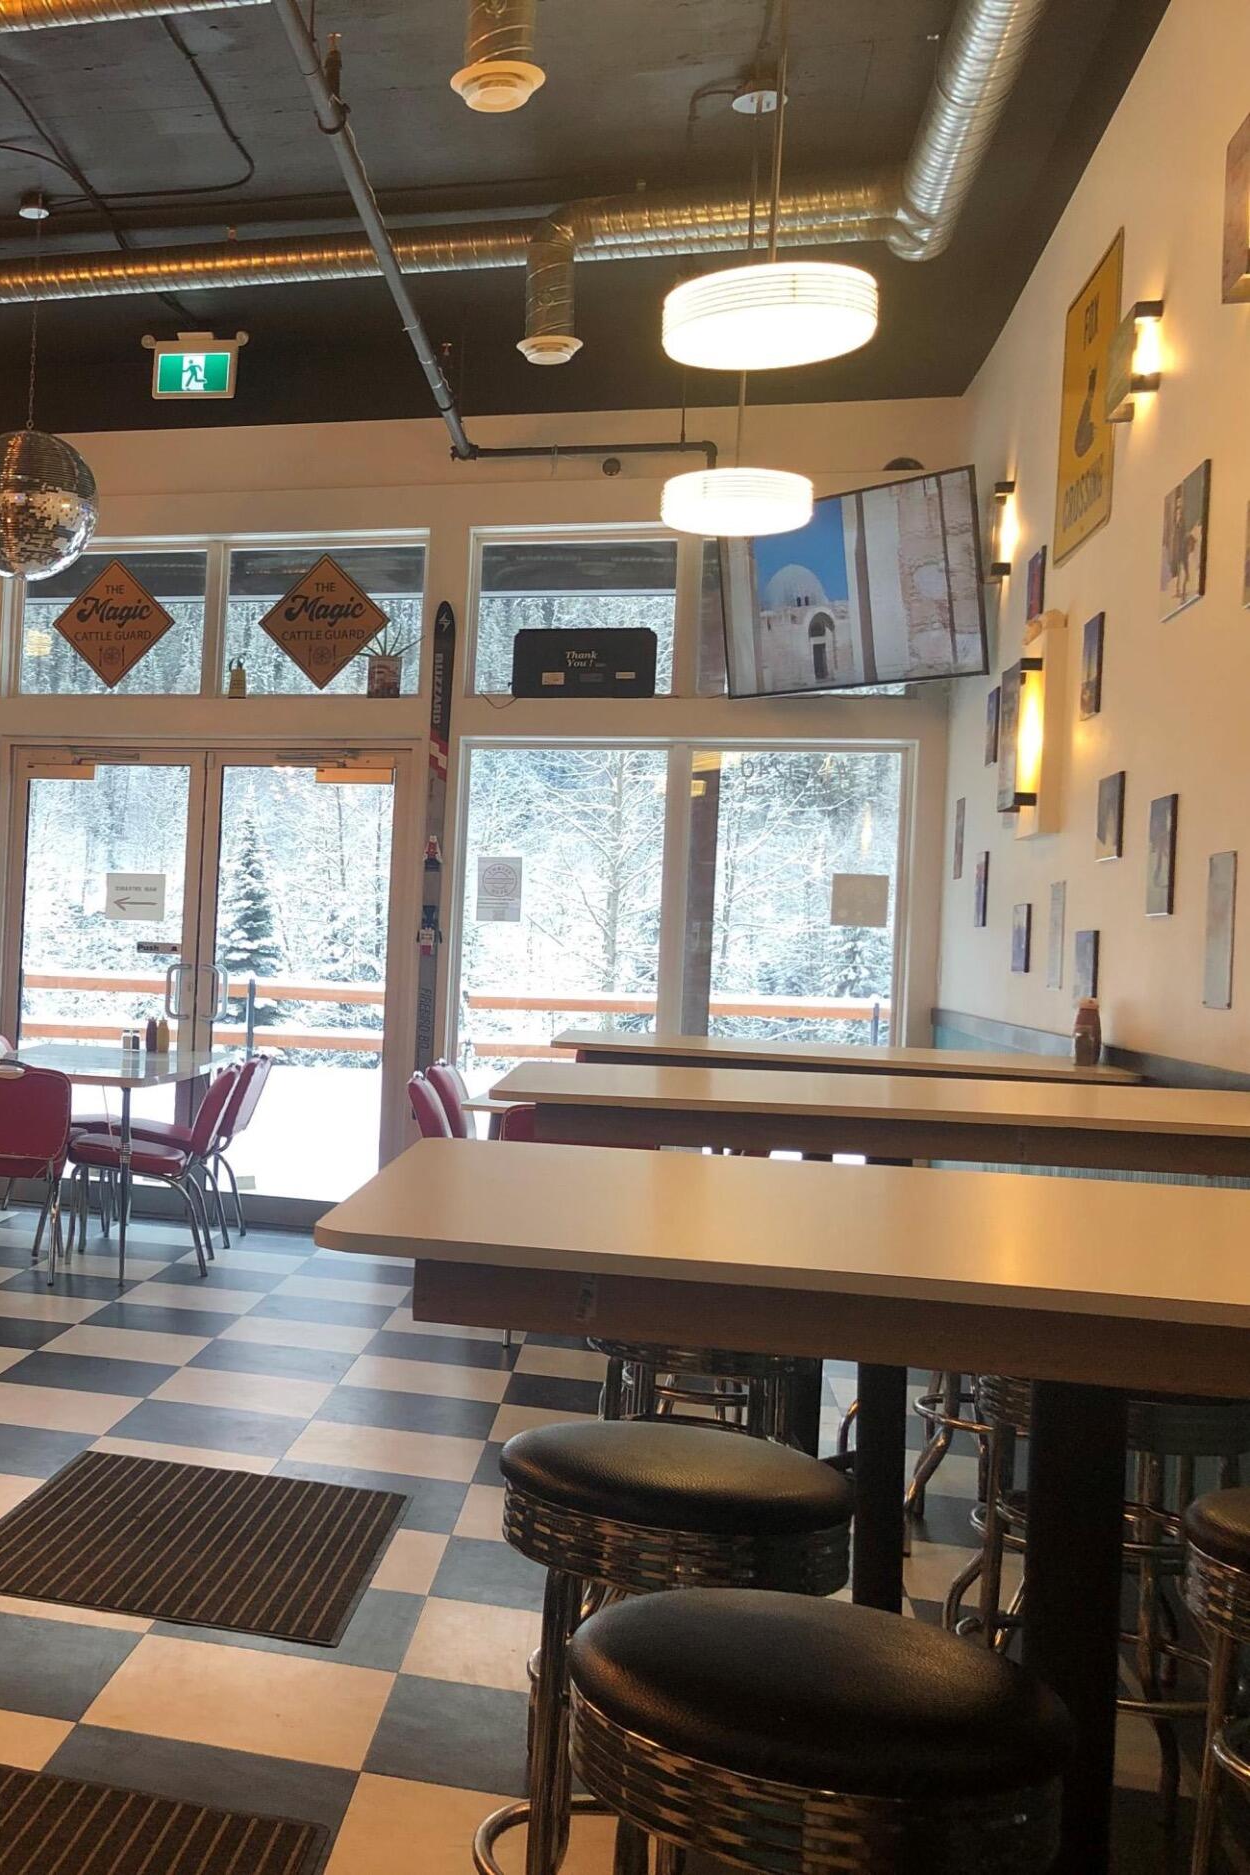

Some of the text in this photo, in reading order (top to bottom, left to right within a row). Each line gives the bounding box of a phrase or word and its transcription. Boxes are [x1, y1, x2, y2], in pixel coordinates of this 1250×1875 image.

[1084, 294, 1100, 350] FOX
[105, 585, 125, 595] THE
[315, 582, 336, 593] THE
[77, 596, 154, 628] Magic
[284, 594, 367, 627] Magic
[74, 629, 152, 641] CATTLE GUARD
[281, 629, 365, 641] CATTLE GUARD
[565, 650, 598, 659] Thank
[432, 652, 444, 724] BLIZZARD
[137, 943, 159, 951] Push
